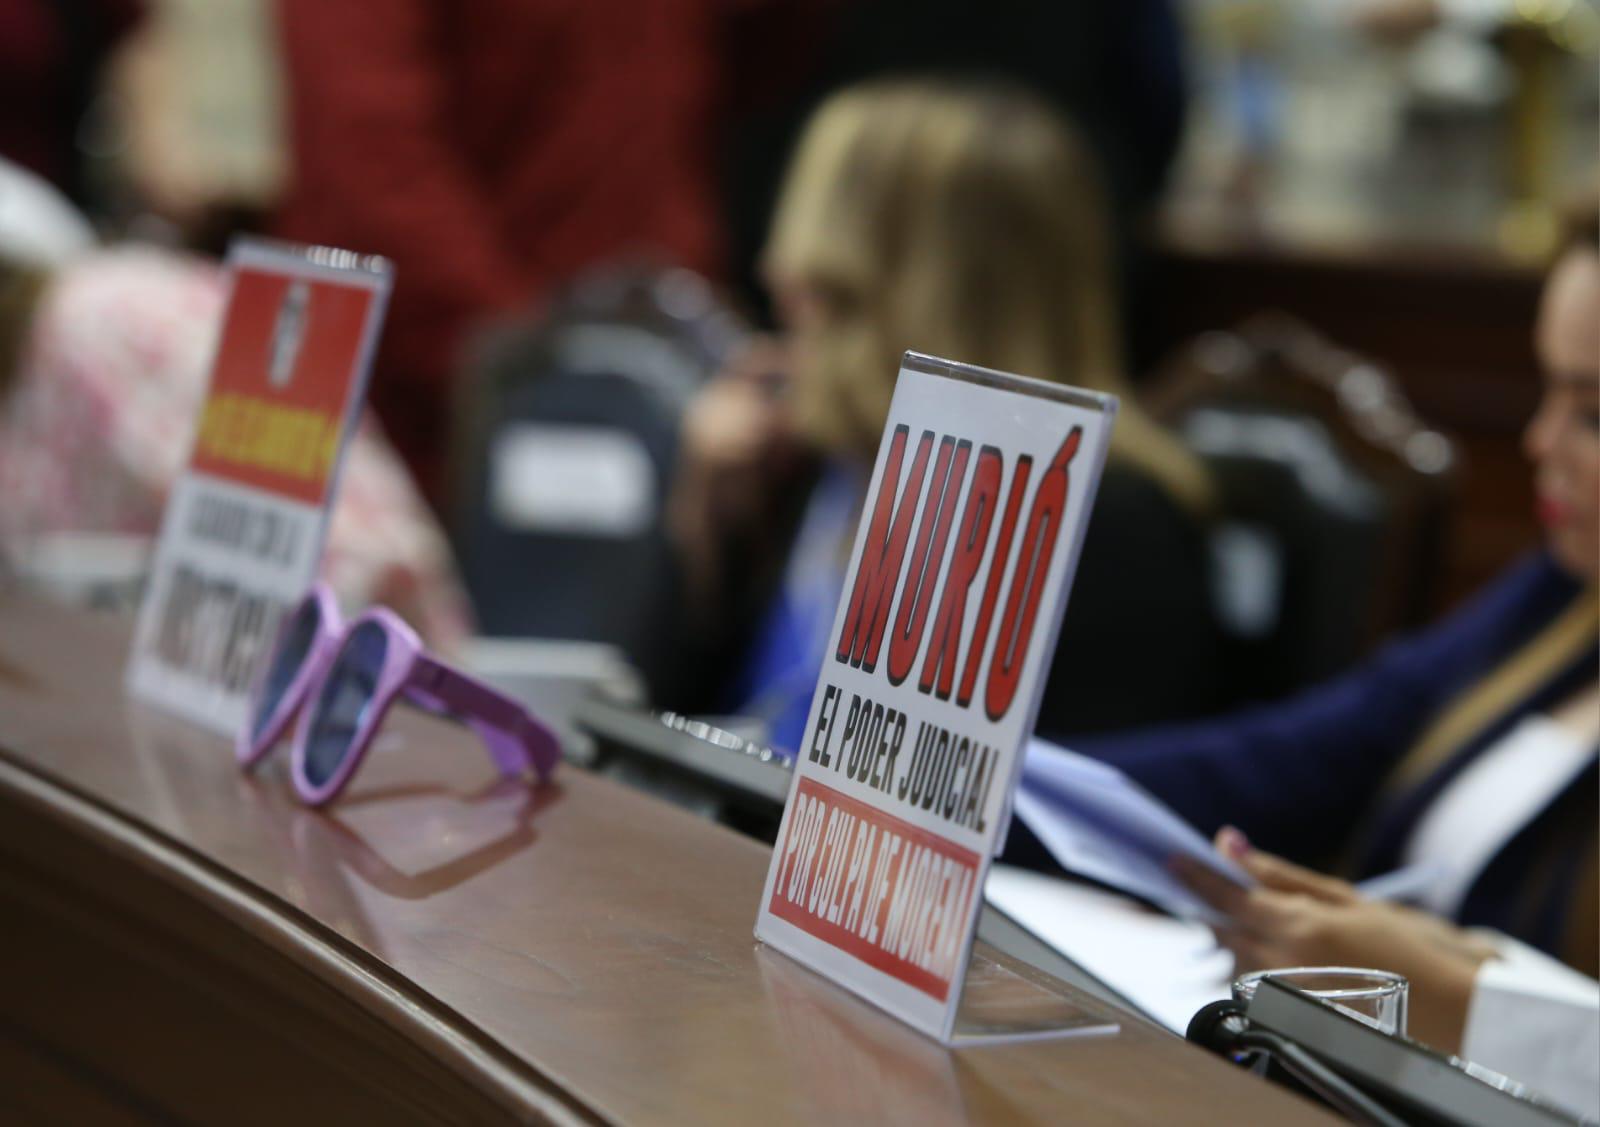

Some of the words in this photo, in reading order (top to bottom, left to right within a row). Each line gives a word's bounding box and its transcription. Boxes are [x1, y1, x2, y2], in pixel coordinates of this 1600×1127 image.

[835, 422, 1084, 723] MURIÓ
[808, 684, 843, 767] EL
[834, 692, 908, 796] PODER
[899, 720, 1000, 834] JUDICIAL
[776, 791, 826, 908] POR
[808, 806, 877, 934] CULPA
[859, 830, 901, 945] DE
[880, 840, 973, 981] MORENA
